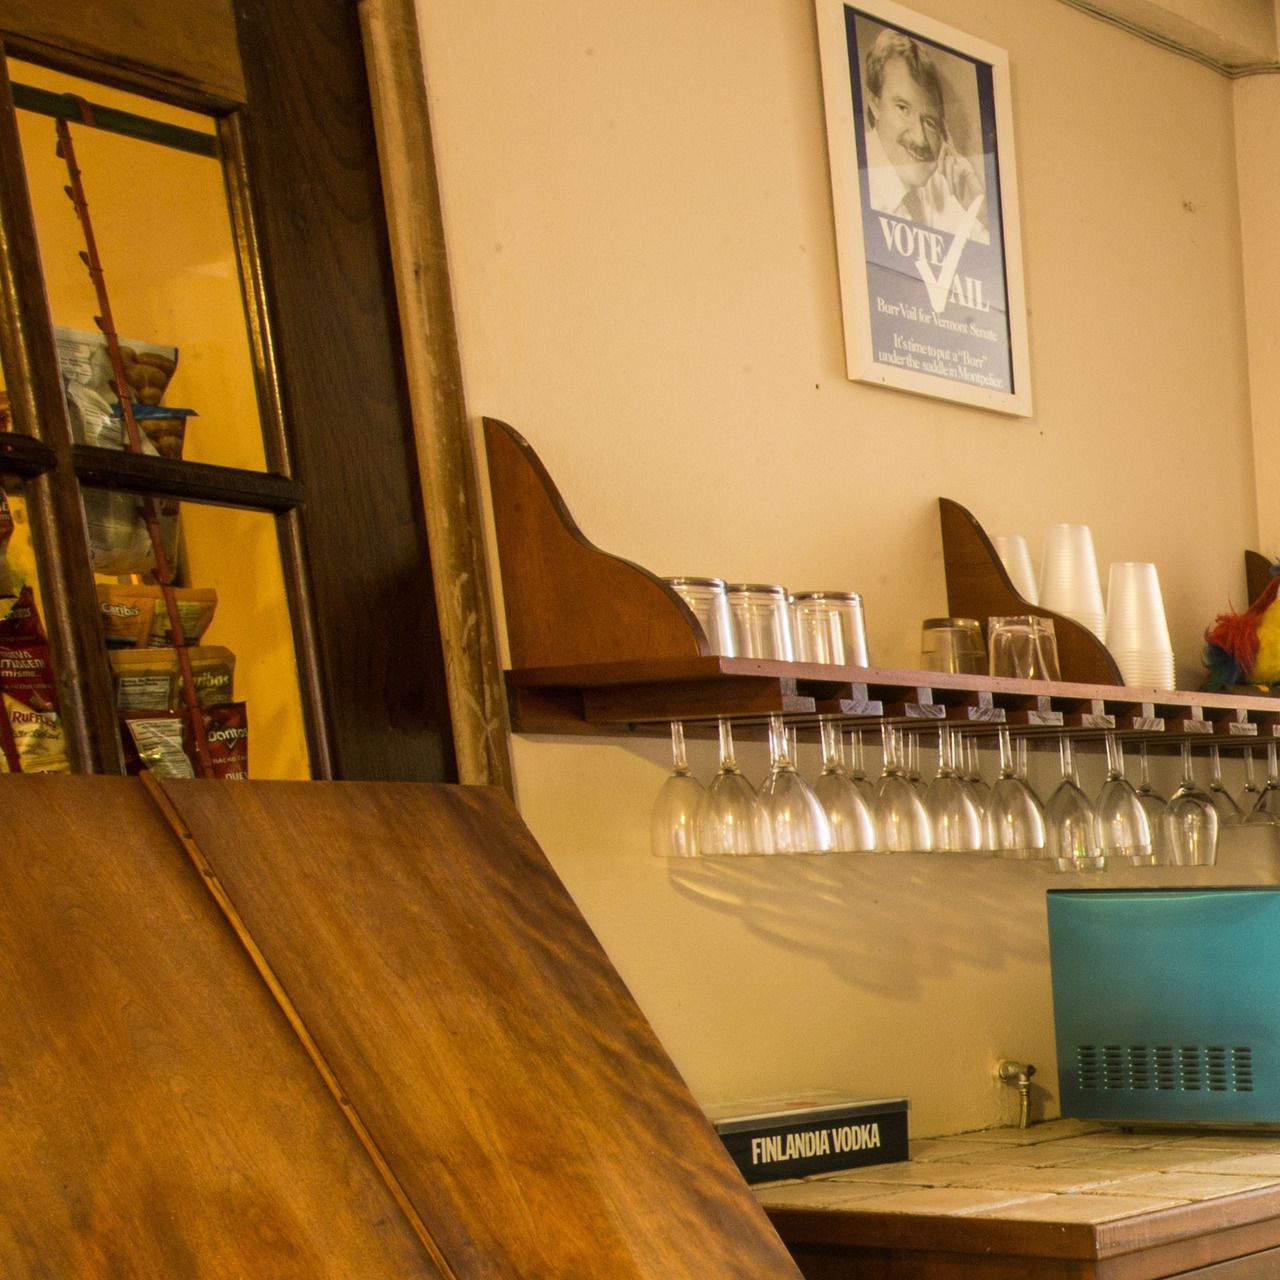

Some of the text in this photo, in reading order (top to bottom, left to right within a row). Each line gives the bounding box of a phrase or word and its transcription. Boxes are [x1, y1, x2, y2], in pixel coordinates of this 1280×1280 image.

[878, 216, 947, 267] VOTE
[877, 296, 899, 316] Burr
[900, 303, 917, 321] Vail
[918, 307, 931, 324] for
[931, 311, 968, 335] Vermont
[878, 350, 905, 365] under
[906, 353, 920, 369] the
[908, 338, 927, 355] time
[751, 1122, 881, 1165] FINLANDIA VODKA
